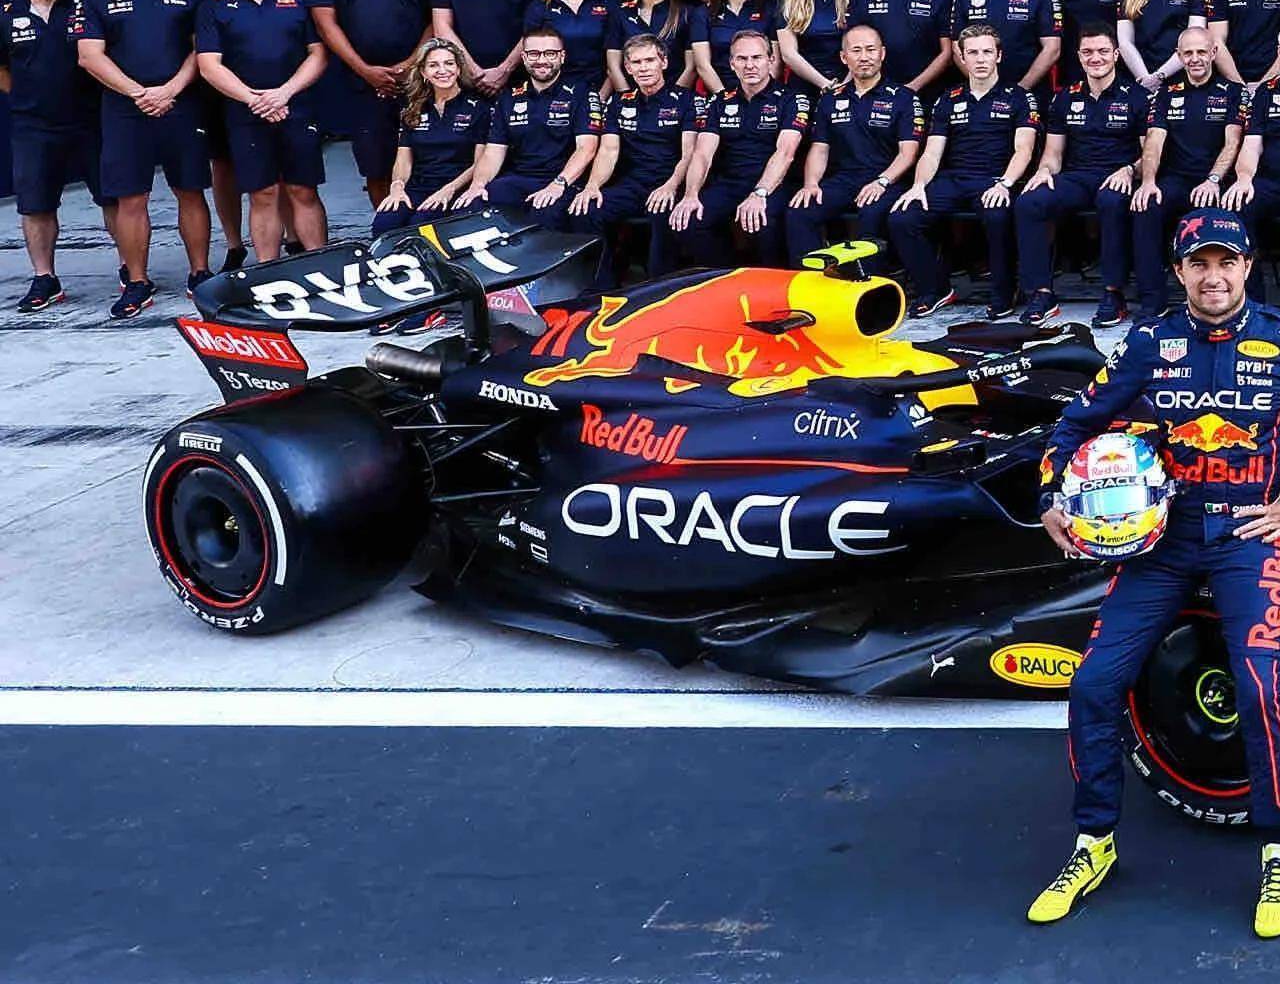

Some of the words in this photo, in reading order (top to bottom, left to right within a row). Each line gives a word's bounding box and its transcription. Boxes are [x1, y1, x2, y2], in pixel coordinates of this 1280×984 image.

[186, 325, 262, 360] Mobil
[980, 362, 1018, 377] Tezos
[1236, 360, 1274, 374] BYBIT
[478, 380, 560, 411] HONDA
[1155, 390, 1274, 411] ORACLE
[794, 411, 861, 440] citrix
[179, 432, 223, 453] PIRELLI
[1080, 476, 1145, 492] ORACLE
[562, 483, 906, 559] ORACLE
